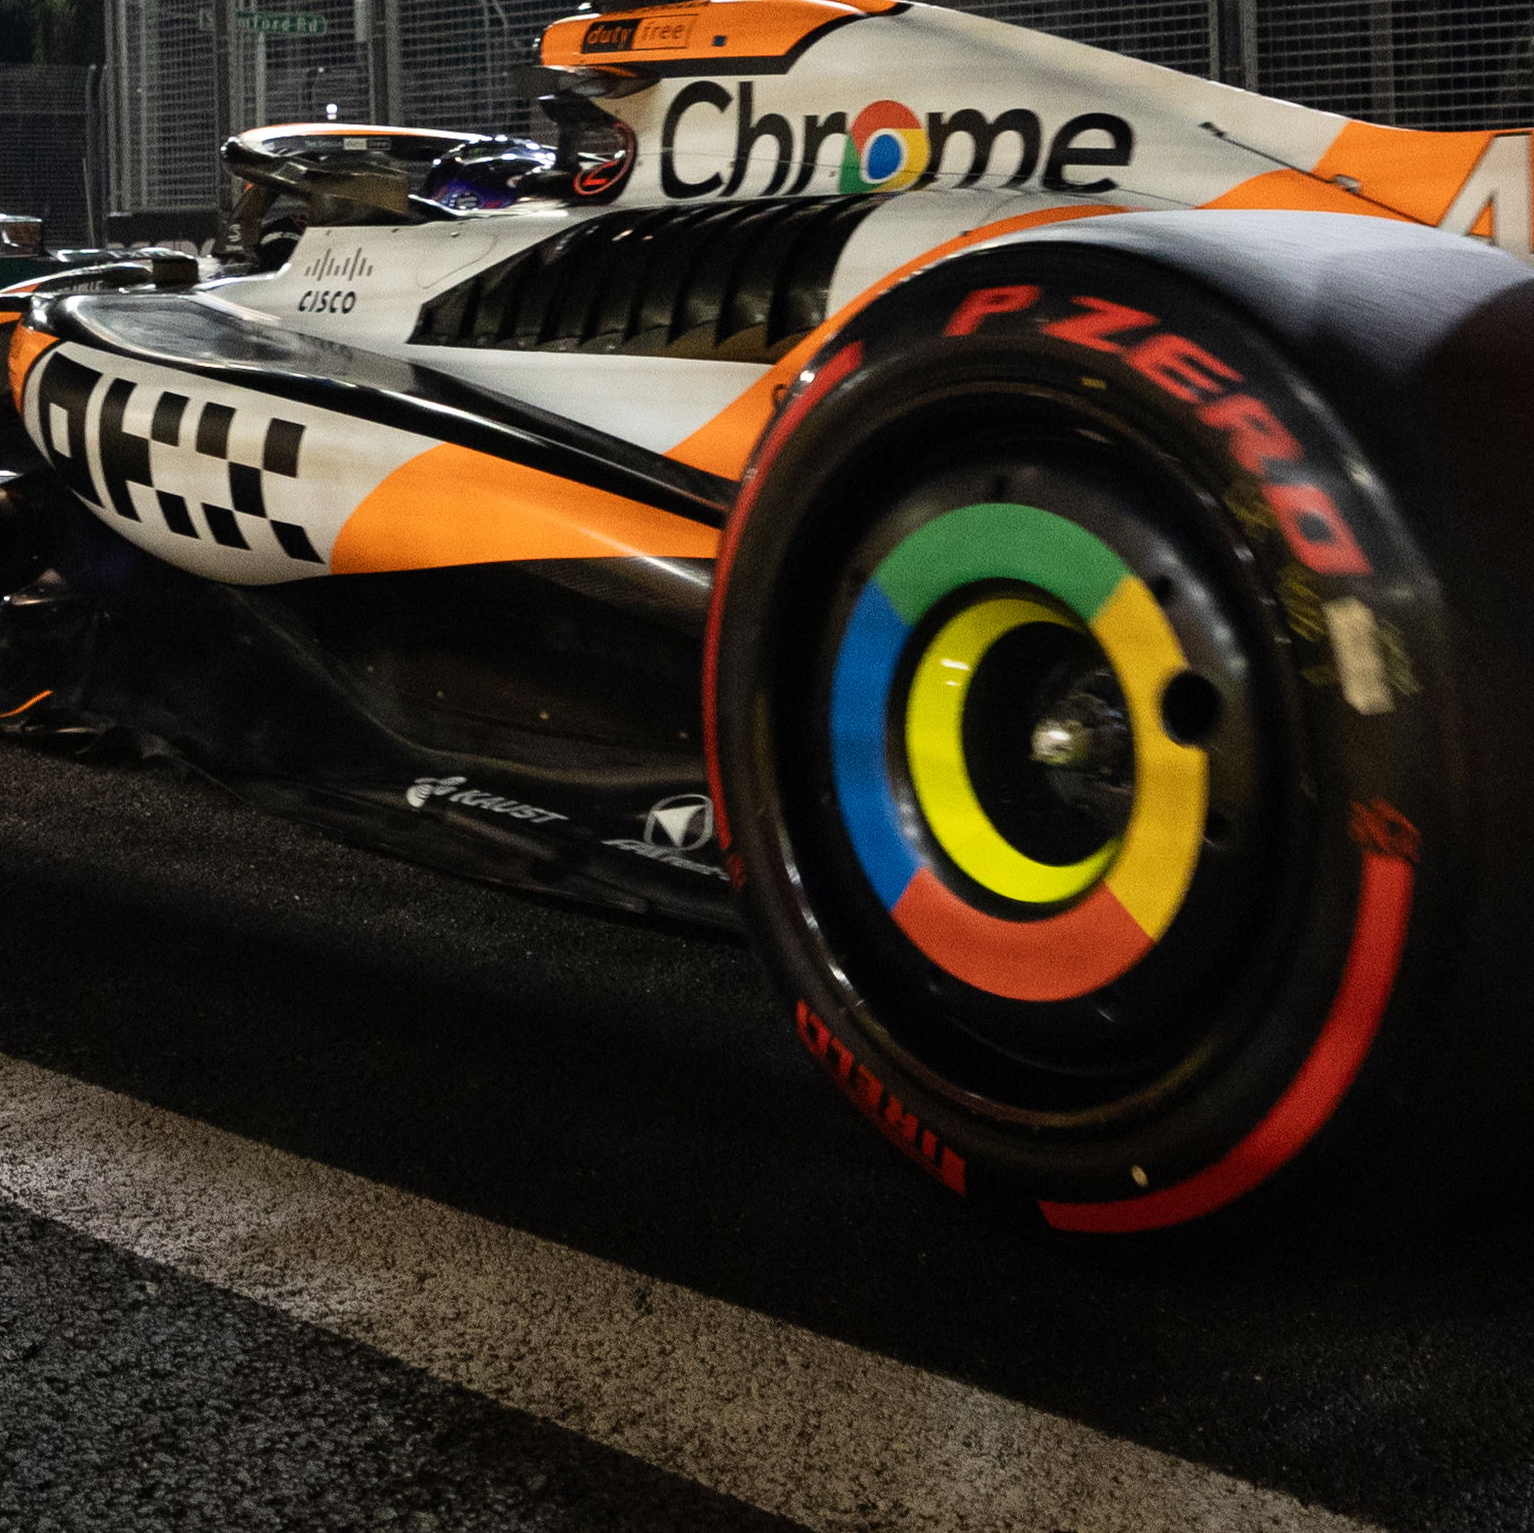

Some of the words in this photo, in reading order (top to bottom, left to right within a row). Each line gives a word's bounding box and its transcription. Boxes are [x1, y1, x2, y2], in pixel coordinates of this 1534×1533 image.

[661, 81, 1134, 198] Chrome
[944, 285, 1042, 338] P
[1039, 296, 1373, 574] ZERO
[450, 789, 569, 823] KAUST
